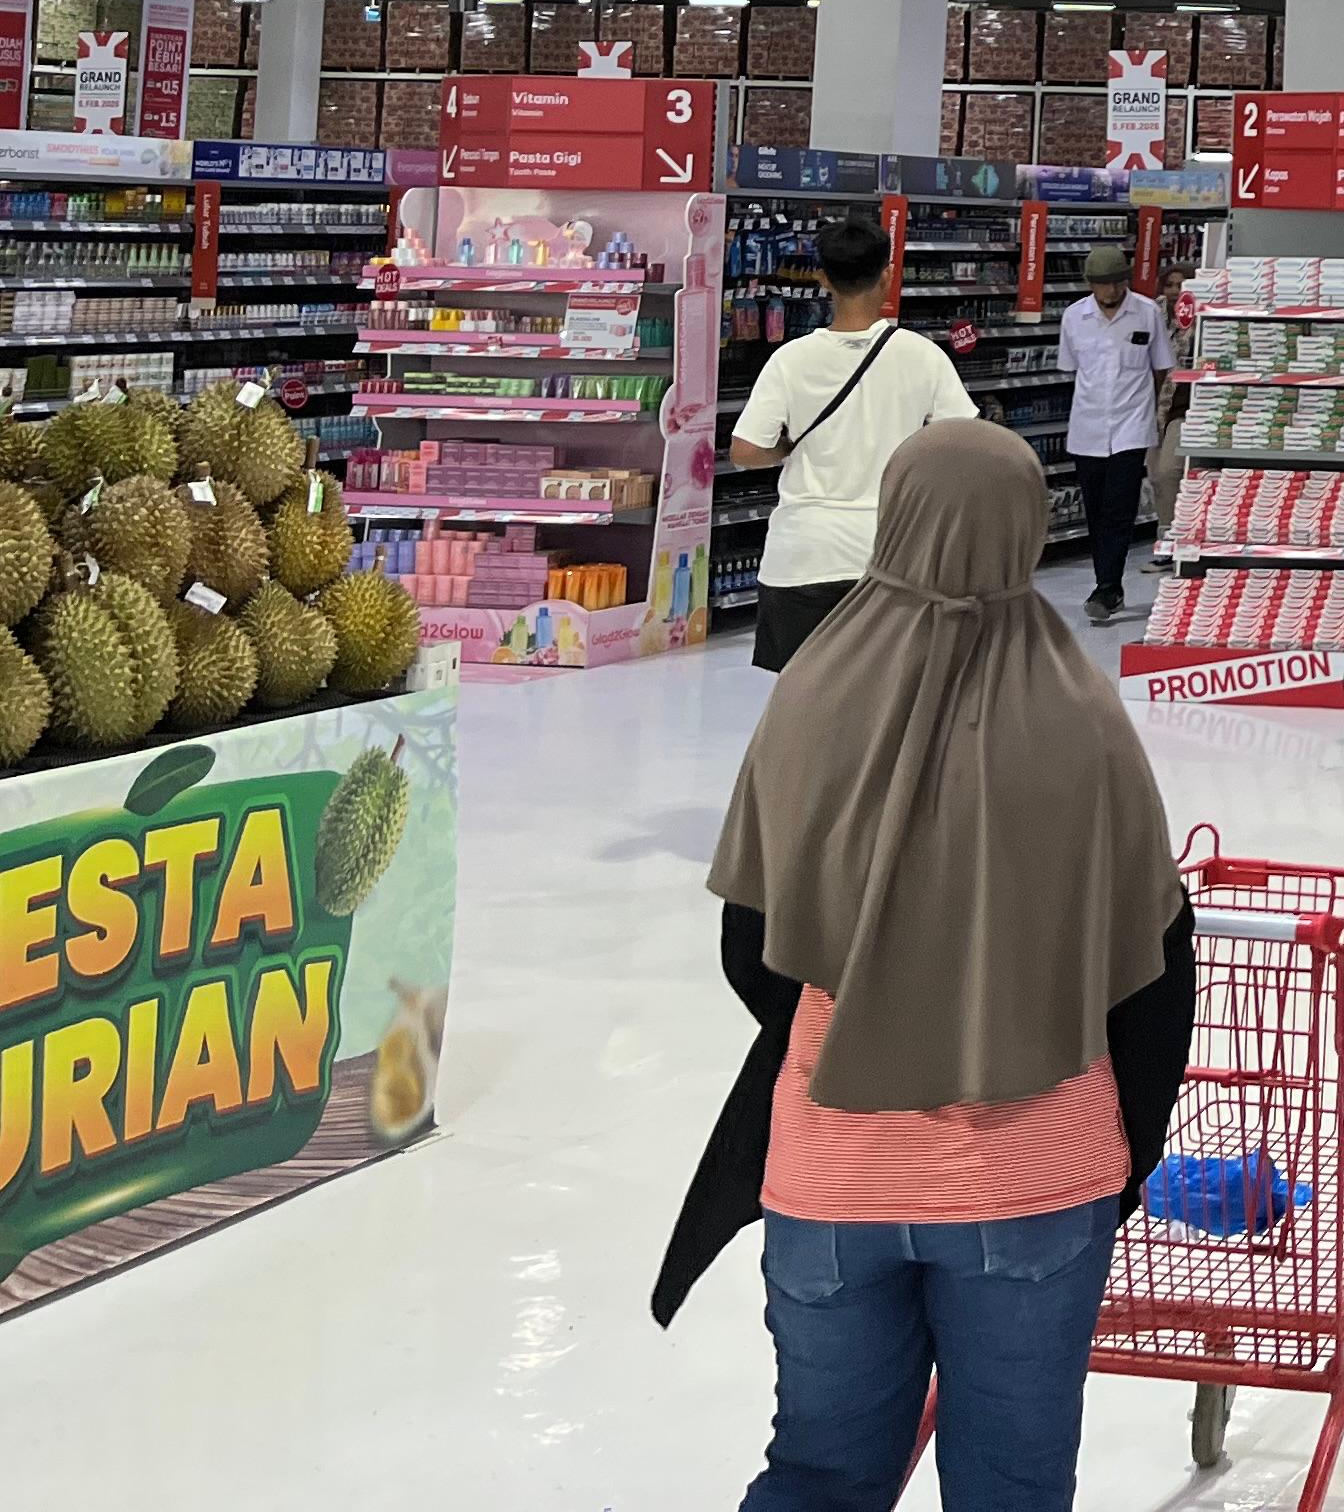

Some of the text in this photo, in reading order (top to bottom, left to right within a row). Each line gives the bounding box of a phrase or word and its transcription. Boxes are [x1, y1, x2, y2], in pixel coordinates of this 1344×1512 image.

[150, 39, 183, 51] POINT
[149, 50, 182, 63] LEBIH
[80, 71, 122, 83] GRAND
[446, 85, 458, 118] 4
[512, 92, 569, 105] Vitamin
[1112, 92, 1161, 105] GRAND
[666, 89, 693, 124] 3
[1112, 104, 1161, 114] RELAUNCH
[1243, 102, 1258, 137] 2
[509, 151, 582, 167] Pasta Gigi
[1264, 168, 1289, 182] Kapas
[1027, 213, 1039, 281] Perawatan Pria
[377, 271, 399, 283] HOT
[1177, 301, 1193, 318] 2+1
[951, 325, 973, 339] HOT
[420, 623, 484, 640] d2Glow
[1148, 651, 1332, 703] PROMOTION
